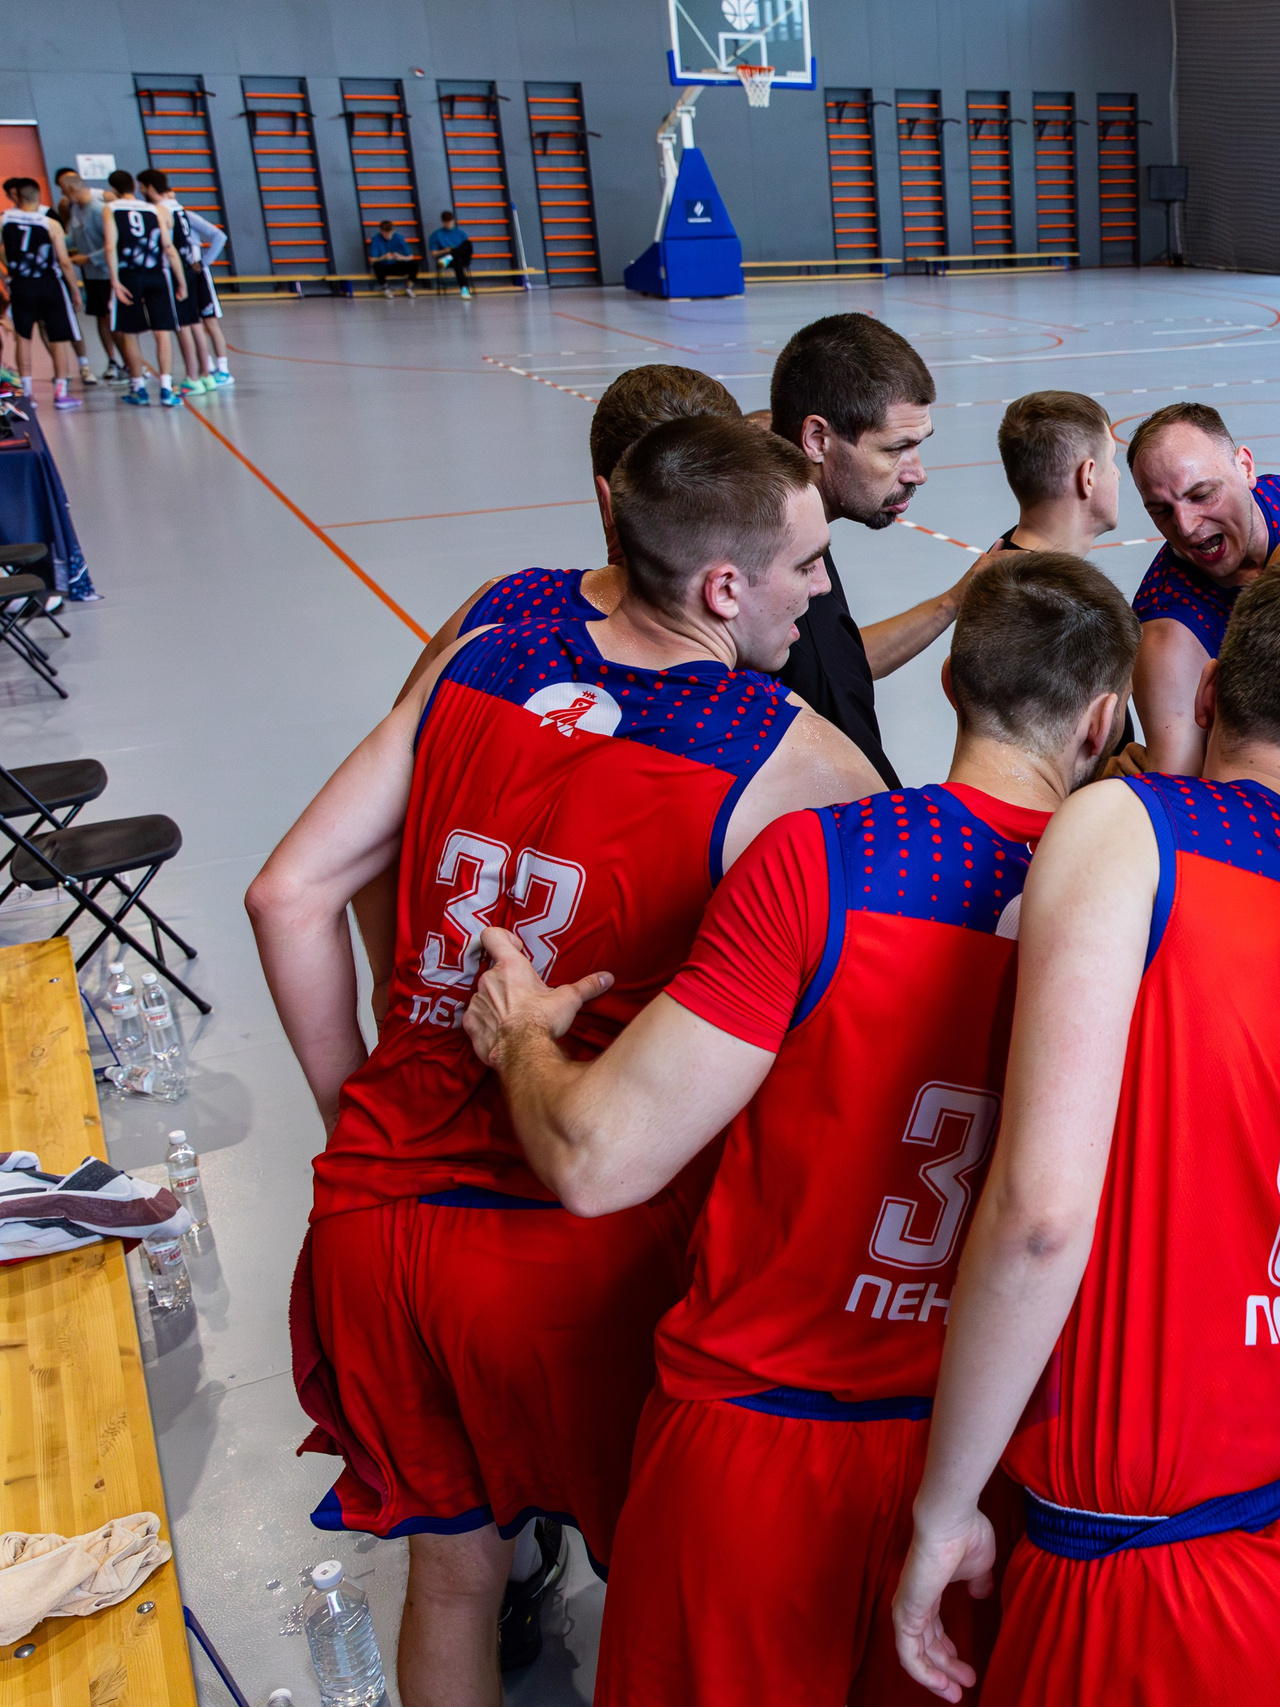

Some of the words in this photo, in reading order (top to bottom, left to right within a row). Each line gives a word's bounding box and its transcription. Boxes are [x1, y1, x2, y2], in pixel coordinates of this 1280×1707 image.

[17, 225, 32, 252] 7
[128, 211, 146, 237] 9
[418, 829, 586, 990] 33
[869, 1081, 1002, 1270] 3
